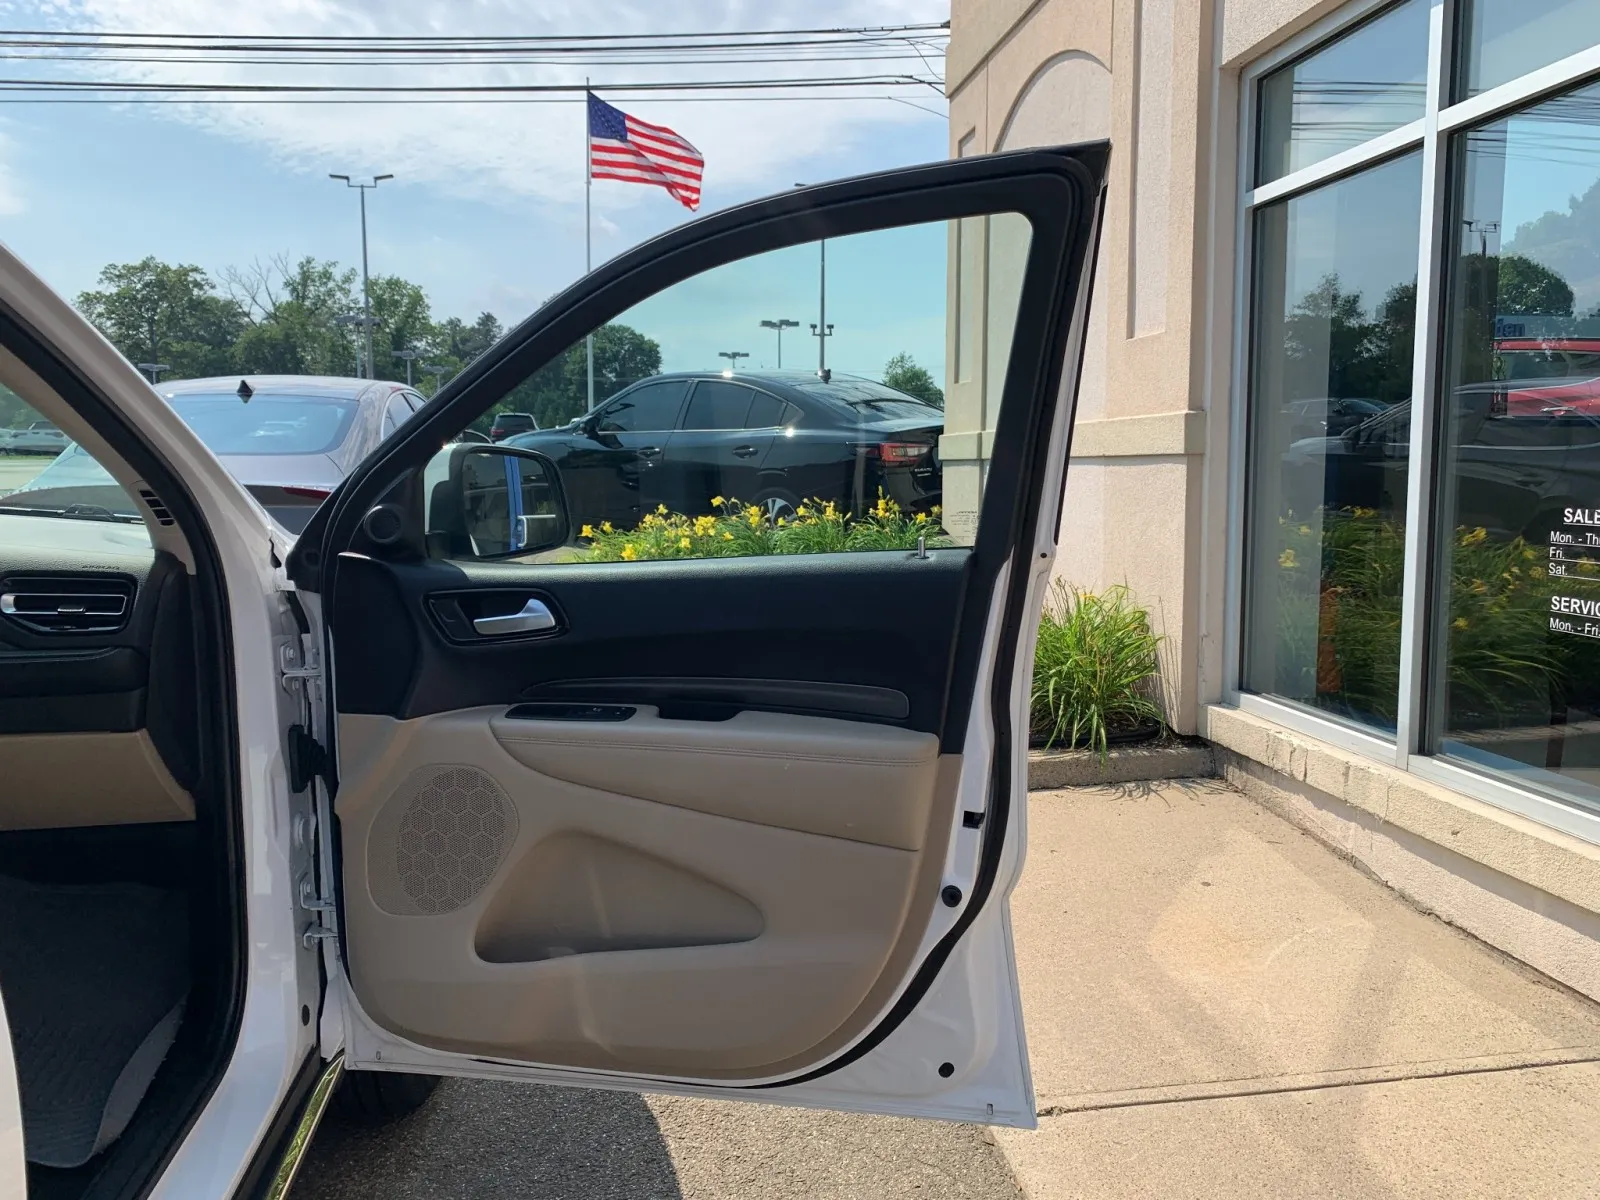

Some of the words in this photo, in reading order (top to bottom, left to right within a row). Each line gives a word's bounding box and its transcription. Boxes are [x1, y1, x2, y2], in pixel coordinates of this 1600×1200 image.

[1550, 530, 1575, 544] Mon.
[1585, 532, 1600, 546] Th
[1549, 546, 1565, 559] Fri.
[1548, 562, 1568, 576] Sat.
[1549, 617, 1574, 632] Mon.
